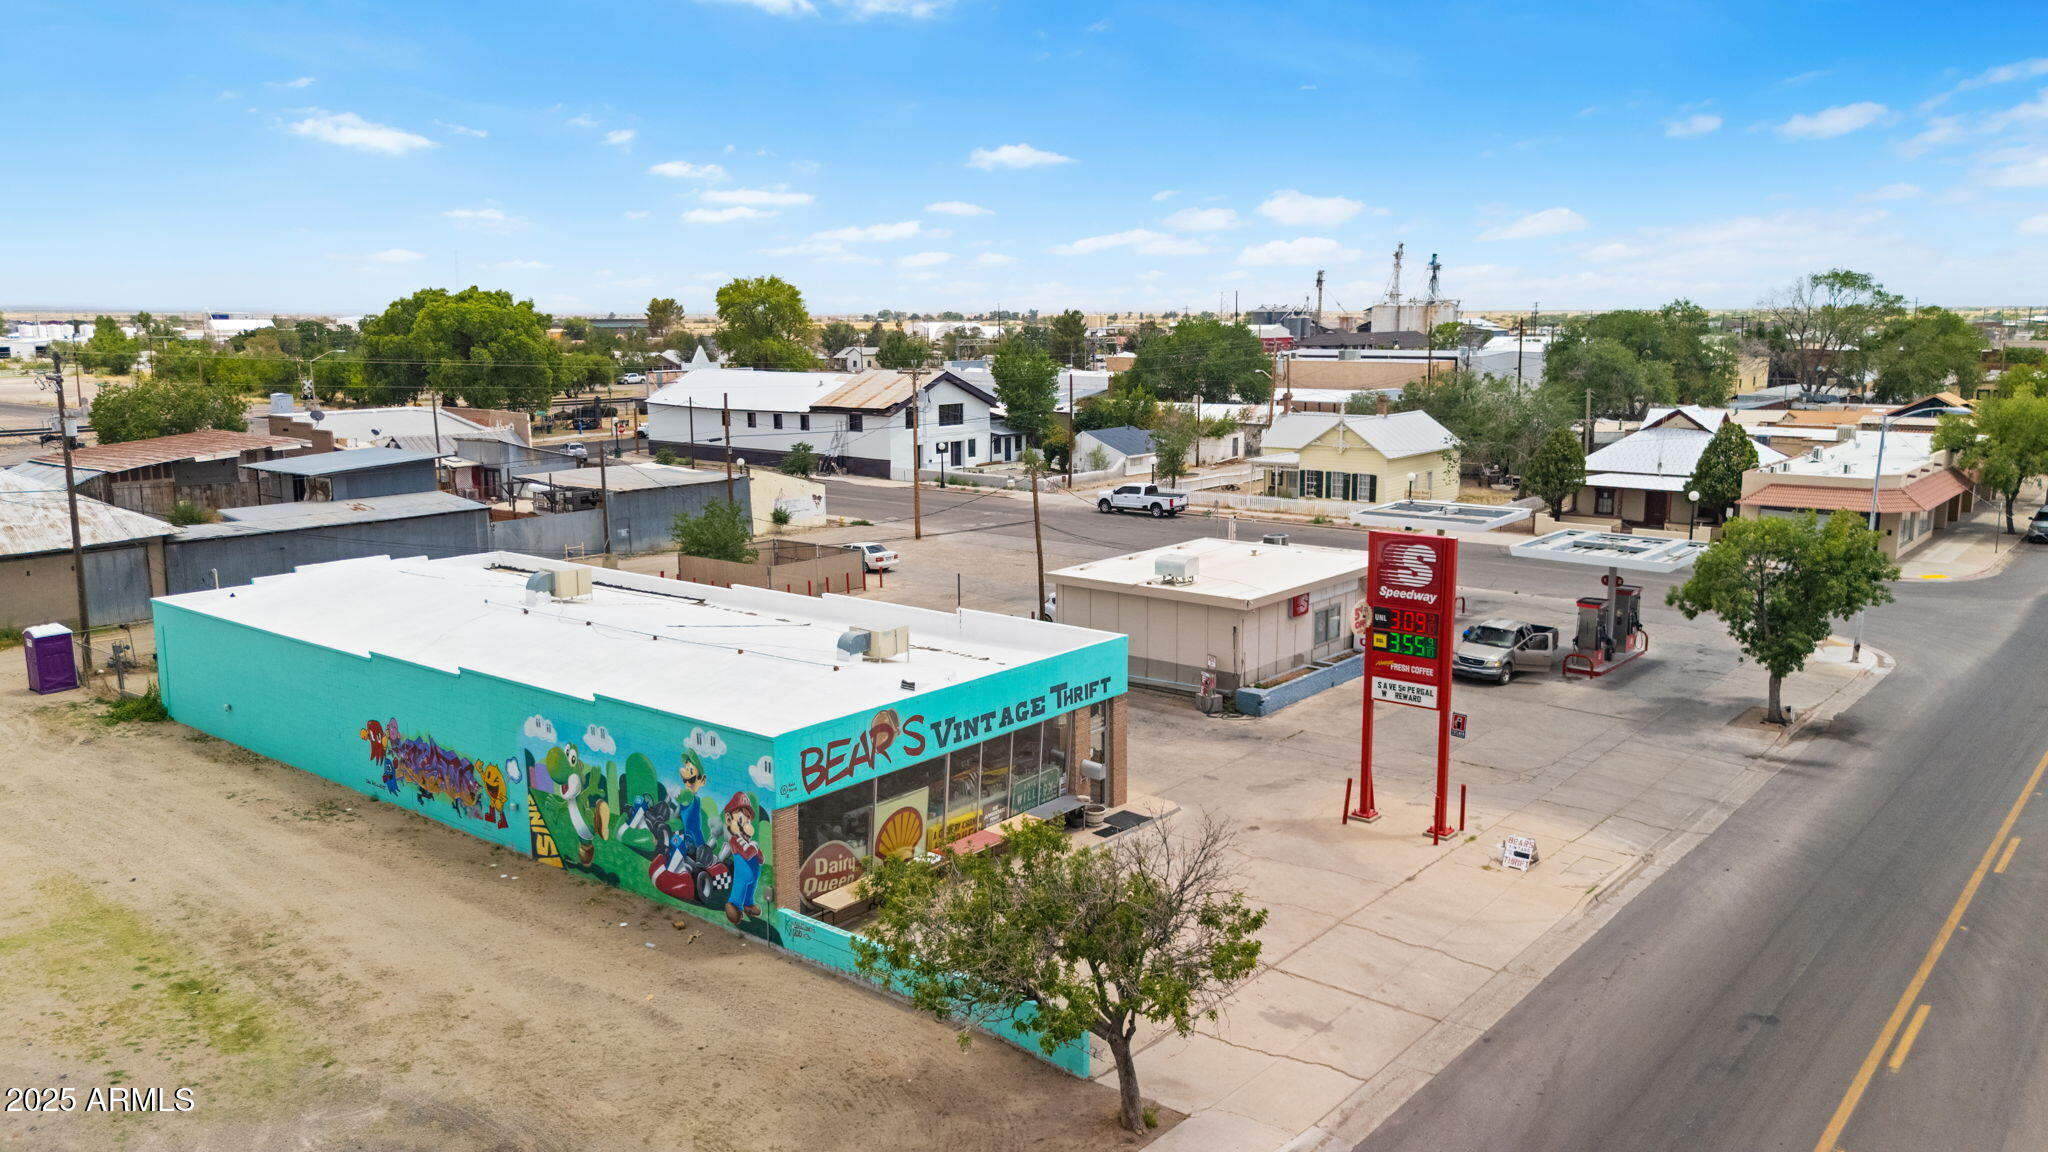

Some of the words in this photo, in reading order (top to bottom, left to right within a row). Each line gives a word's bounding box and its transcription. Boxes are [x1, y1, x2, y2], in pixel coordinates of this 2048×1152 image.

[1379, 585, 1438, 604] Speedway
[1374, 613, 1387, 622] UNL
[1390, 663, 1410, 673] FRESH
[1411, 665, 1434, 677] COFFEE
[930, 695, 1046, 748] VINTAGE
[1050, 676, 1112, 709] THRIFT
[815, 853, 856, 876] Dairy
[803, 873, 855, 897] Queen
